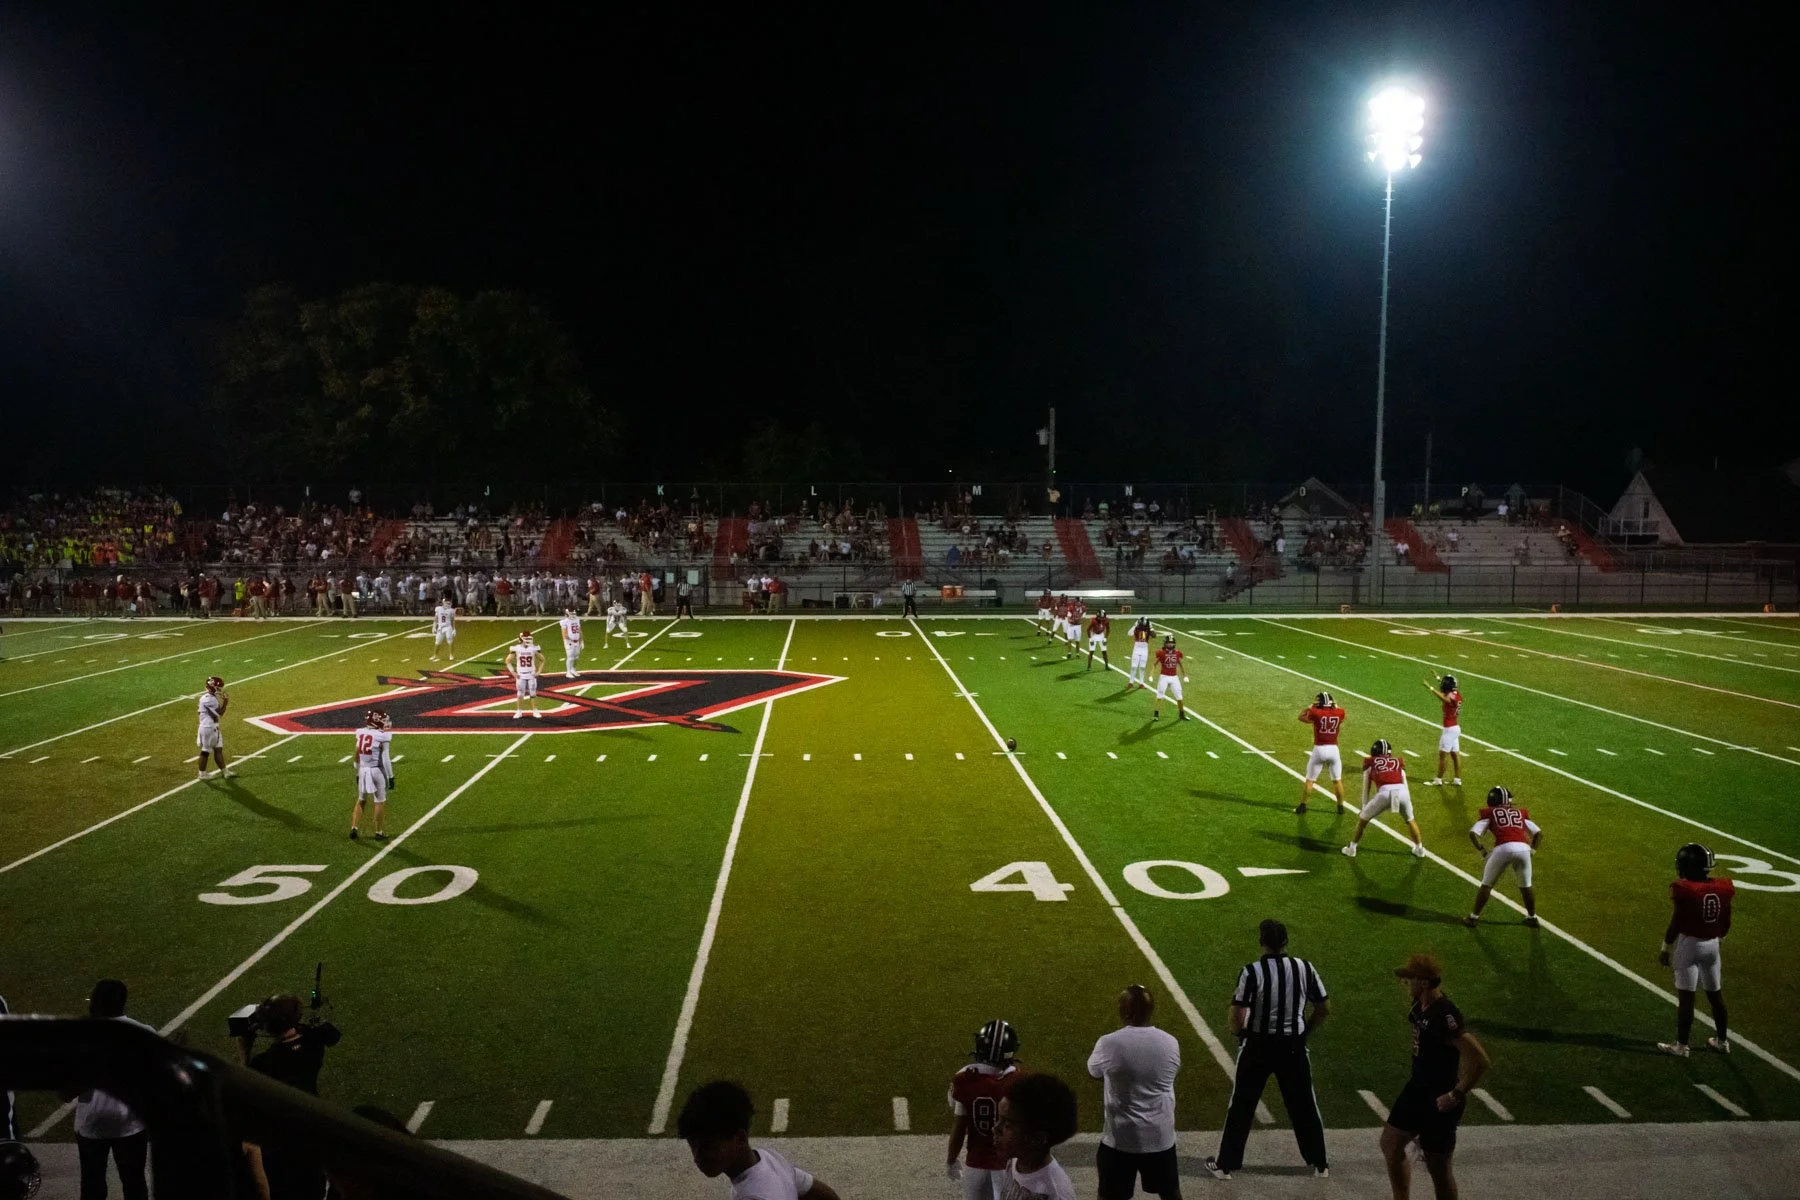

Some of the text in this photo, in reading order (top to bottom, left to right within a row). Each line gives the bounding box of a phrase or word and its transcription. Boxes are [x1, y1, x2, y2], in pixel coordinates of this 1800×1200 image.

[657, 484, 665, 496] K
[810, 485, 818, 496] L
[972, 485, 982, 497] M
[1125, 485, 1133, 497] N
[1461, 486, 1469, 497] P
[519, 655, 533, 668] 69
[1318, 715, 1340, 735] 17
[359, 733, 373, 756] 12
[1374, 756, 1401, 773] 27
[1492, 807, 1524, 829] 82
[1702, 893, 1721, 923] 0
